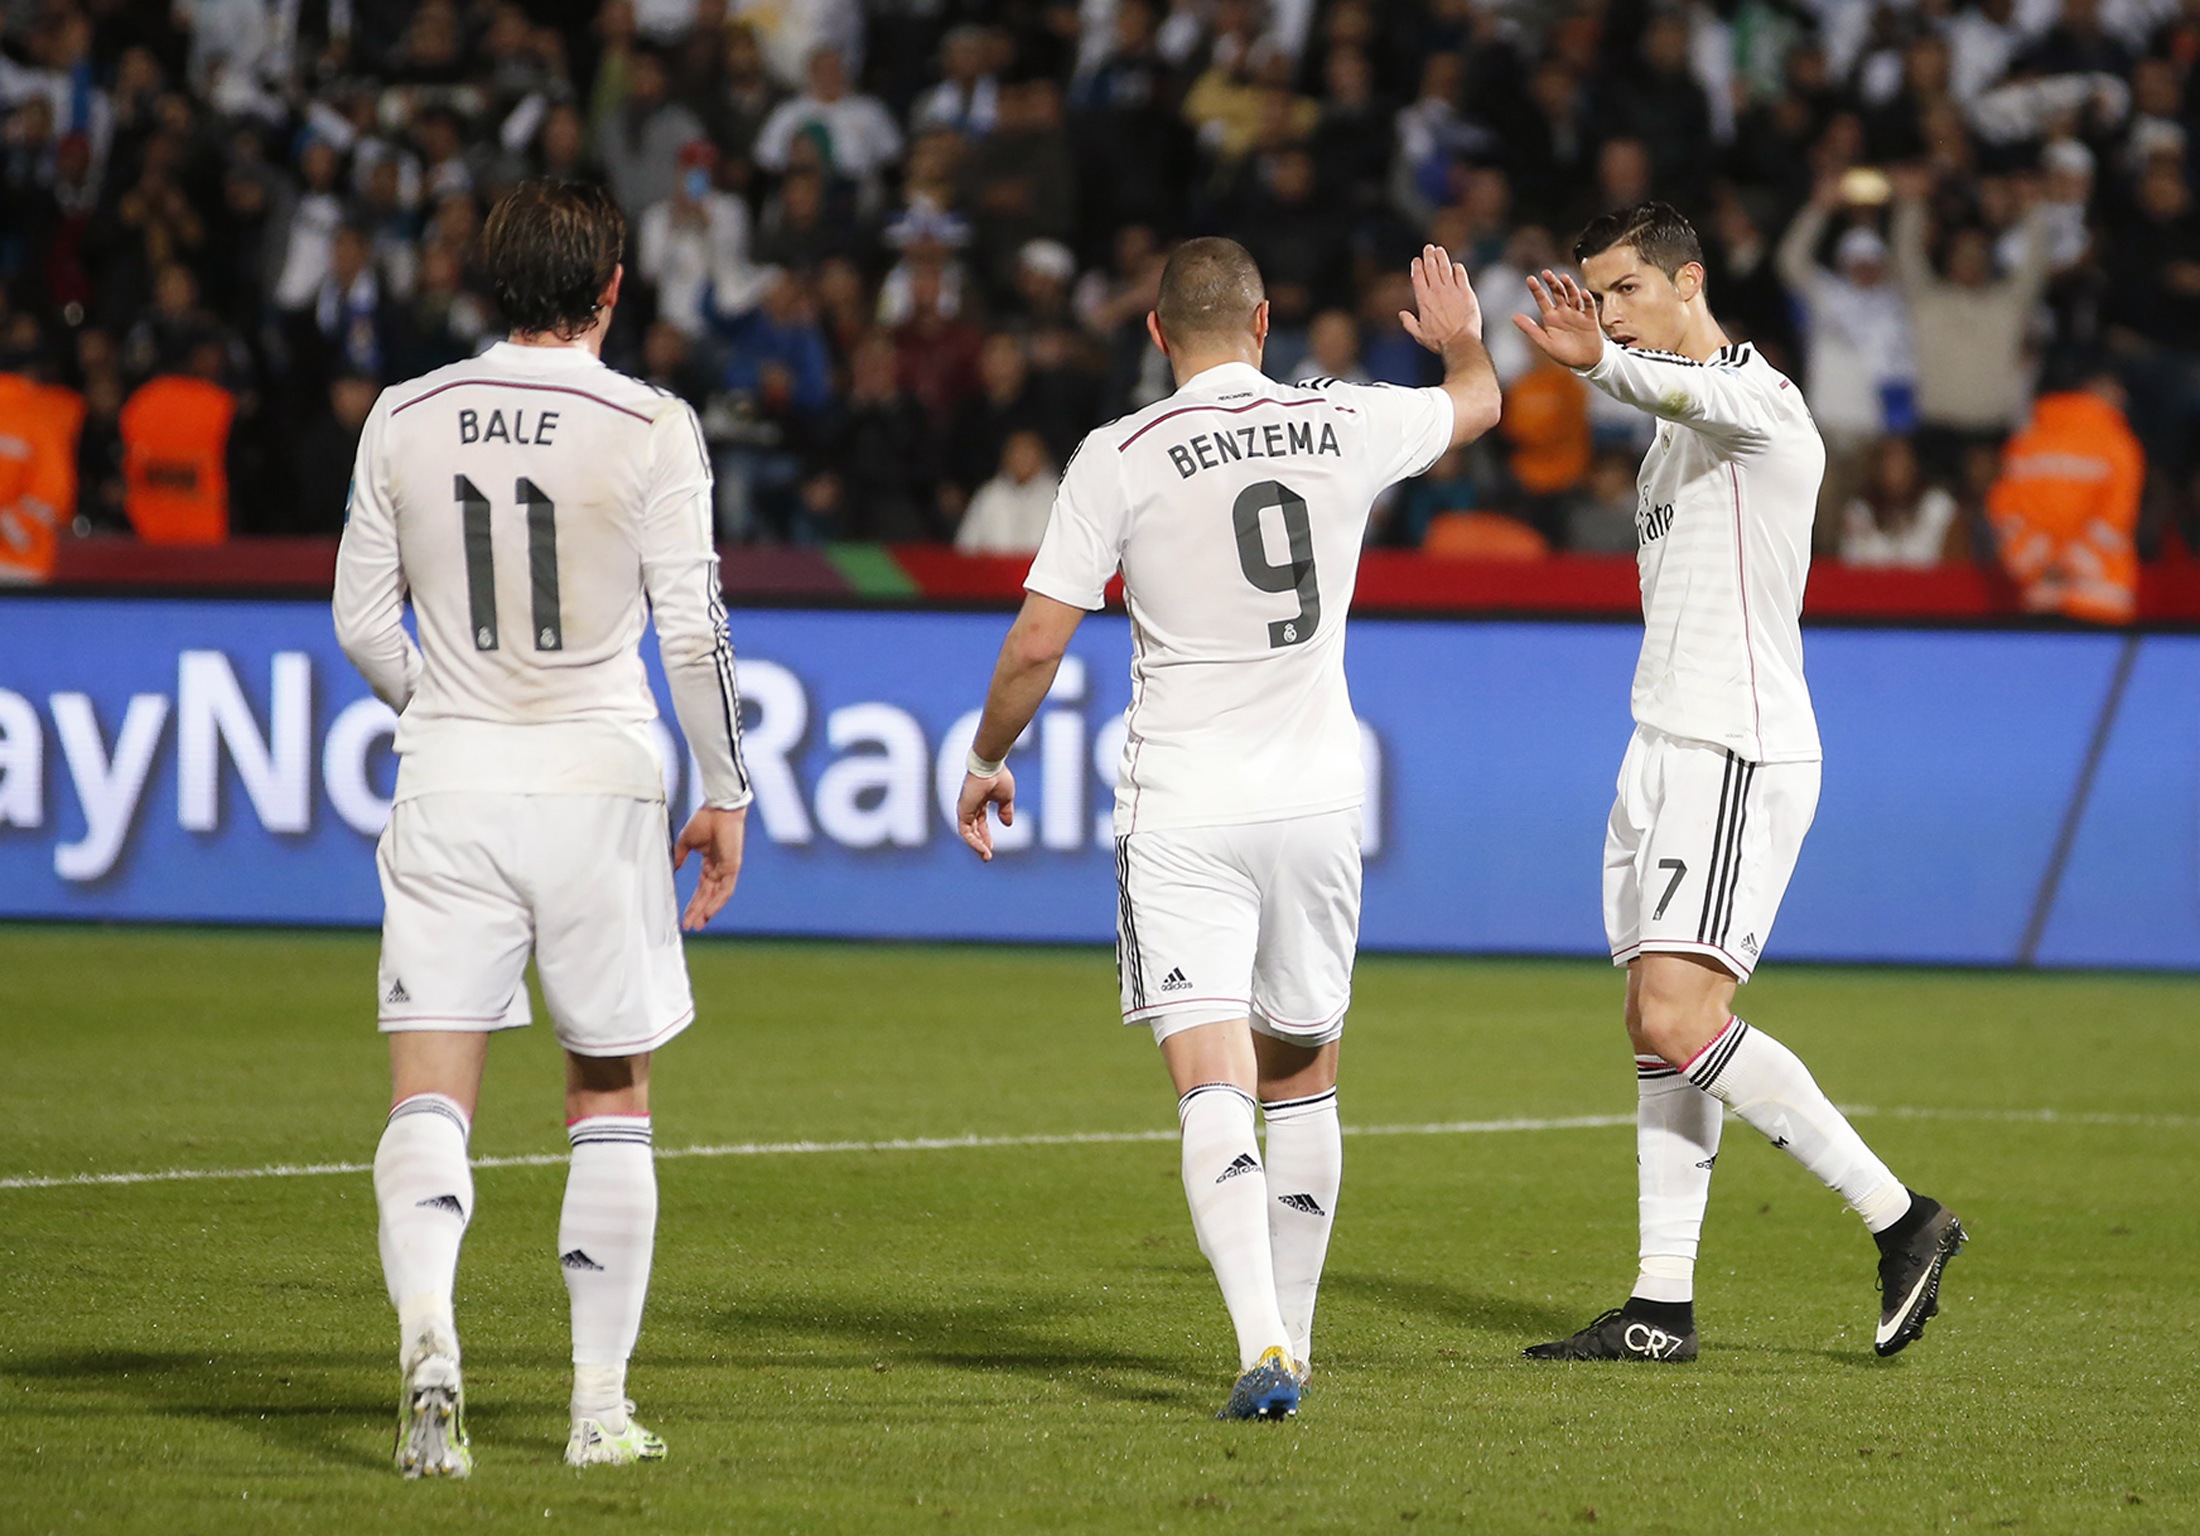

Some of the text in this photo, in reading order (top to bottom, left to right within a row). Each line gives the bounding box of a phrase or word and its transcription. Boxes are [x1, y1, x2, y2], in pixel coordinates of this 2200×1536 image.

[458, 408, 560, 446] BALE
[1167, 421, 1342, 480] BENZEMA
[453, 473, 563, 651] 11
[1232, 479, 1321, 649] 9
[1652, 858, 1688, 921] 7
[1624, 1323, 1684, 1360] CR7
